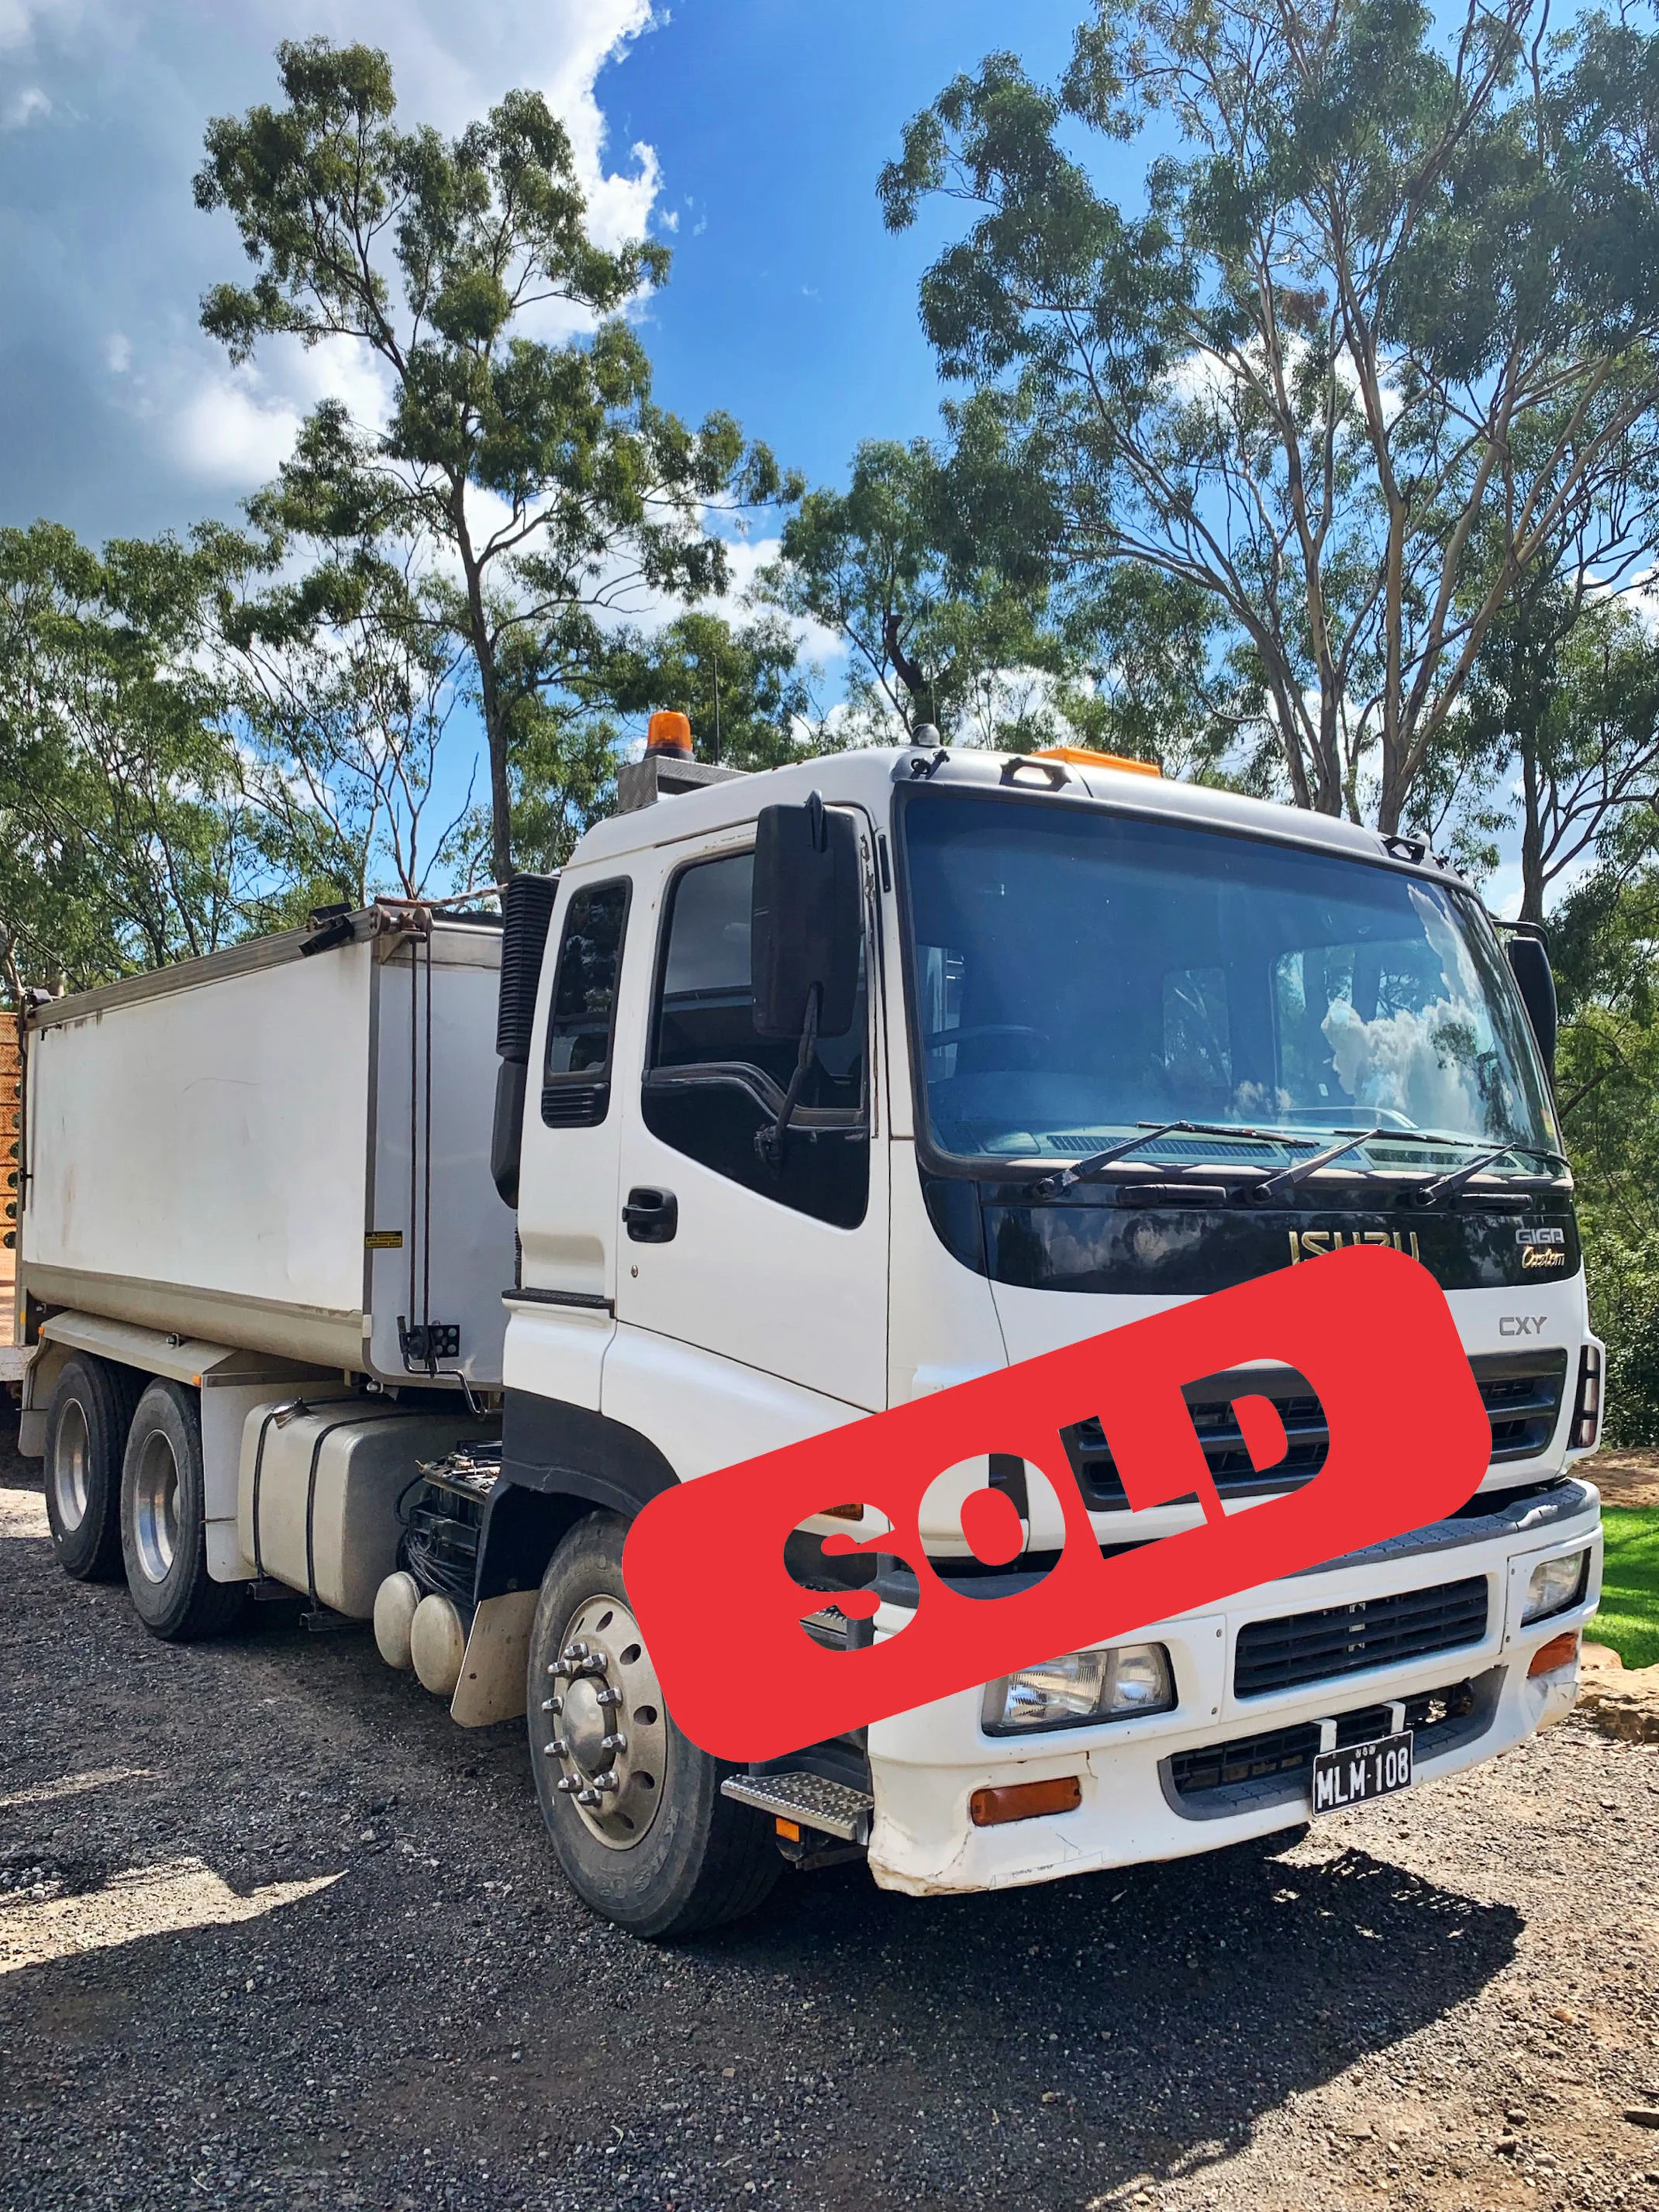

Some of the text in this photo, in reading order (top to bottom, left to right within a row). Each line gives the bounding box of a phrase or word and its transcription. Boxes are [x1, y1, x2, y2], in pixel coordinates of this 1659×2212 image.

[1515, 1228, 1565, 1244] GIGA
[1522, 1244, 1565, 1269] Custom
[1499, 1316, 1548, 1336] CXY
